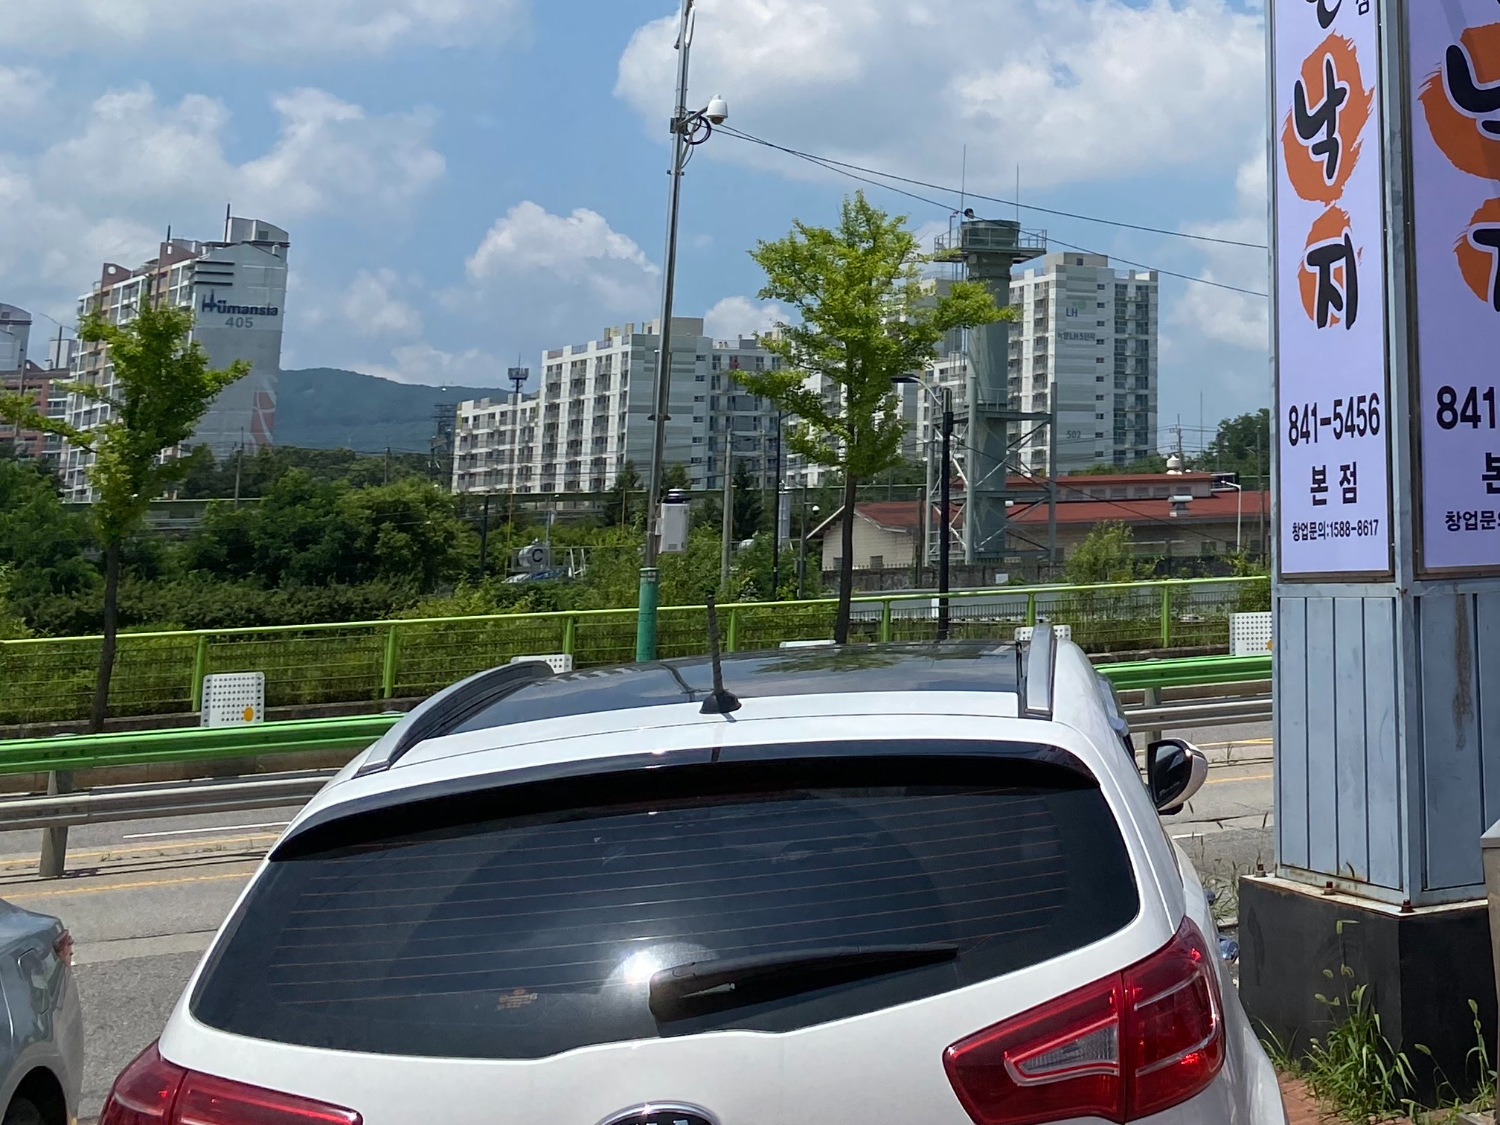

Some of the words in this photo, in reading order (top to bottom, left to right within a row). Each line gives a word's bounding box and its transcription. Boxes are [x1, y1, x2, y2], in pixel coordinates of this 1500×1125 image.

[1066, 307, 1078, 317] LH
[225, 317, 253, 329] 405
[1287, 392, 1381, 447] 841-5456
[532, 548, 544, 563] C
